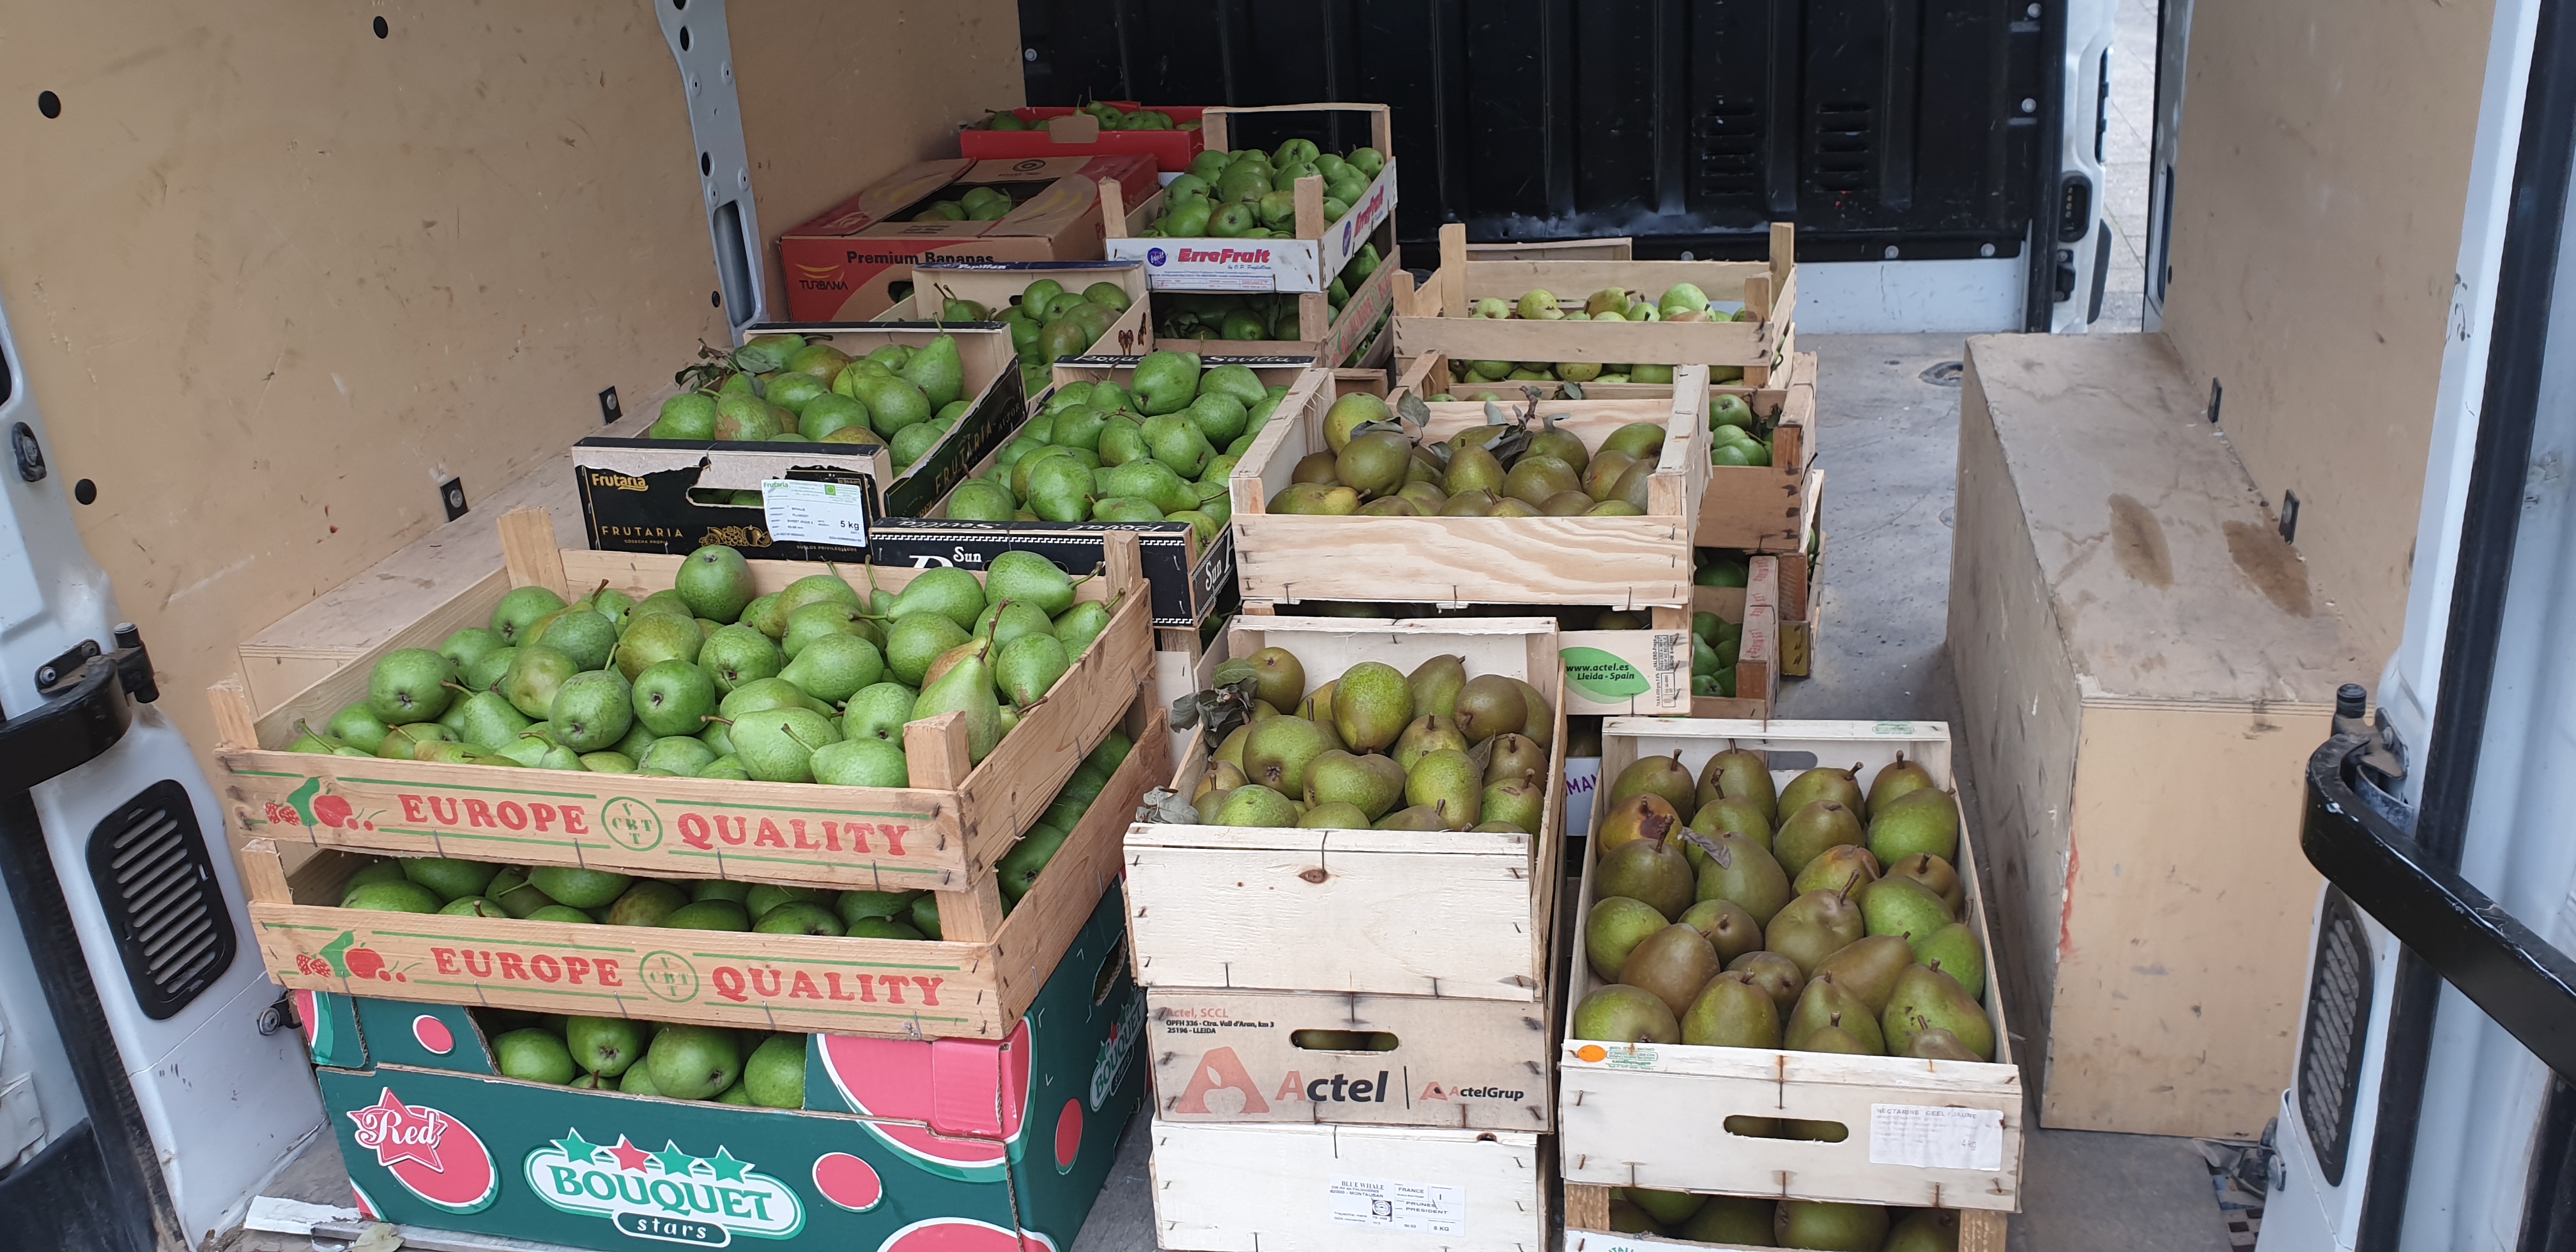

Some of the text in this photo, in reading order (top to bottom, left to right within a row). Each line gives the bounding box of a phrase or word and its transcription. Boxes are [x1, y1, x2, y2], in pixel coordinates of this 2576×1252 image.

[847, 251, 993, 264] Premium Bananas
[799, 280, 848, 290] TURBANA
[935, 418, 992, 495] FRUTARIA
[592, 473, 647, 487] Frutaria
[601, 526, 684, 537] FRUTARIA
[848, 521, 859, 531] kg
[953, 546, 983, 563] Sun
[1206, 559, 1222, 591] Sun
[1566, 663, 1629, 672] www.actel.es
[1609, 672, 1634, 681] Spain
[397, 794, 910, 855] EUROPE QUALITY
[431, 947, 944, 1006] EUROPE QUALITY
[1200, 1008, 1229, 1018] SCCL
[1095, 1001, 1142, 1099] BOUQUET
[1275, 1070, 1524, 1103] Actel ActelGrup
[358, 1108, 436, 1145] Red
[1968, 1141, 1976, 1150] kg
[546, 1164, 774, 1221] BOUQUET
[637, 1218, 707, 1239] stars
